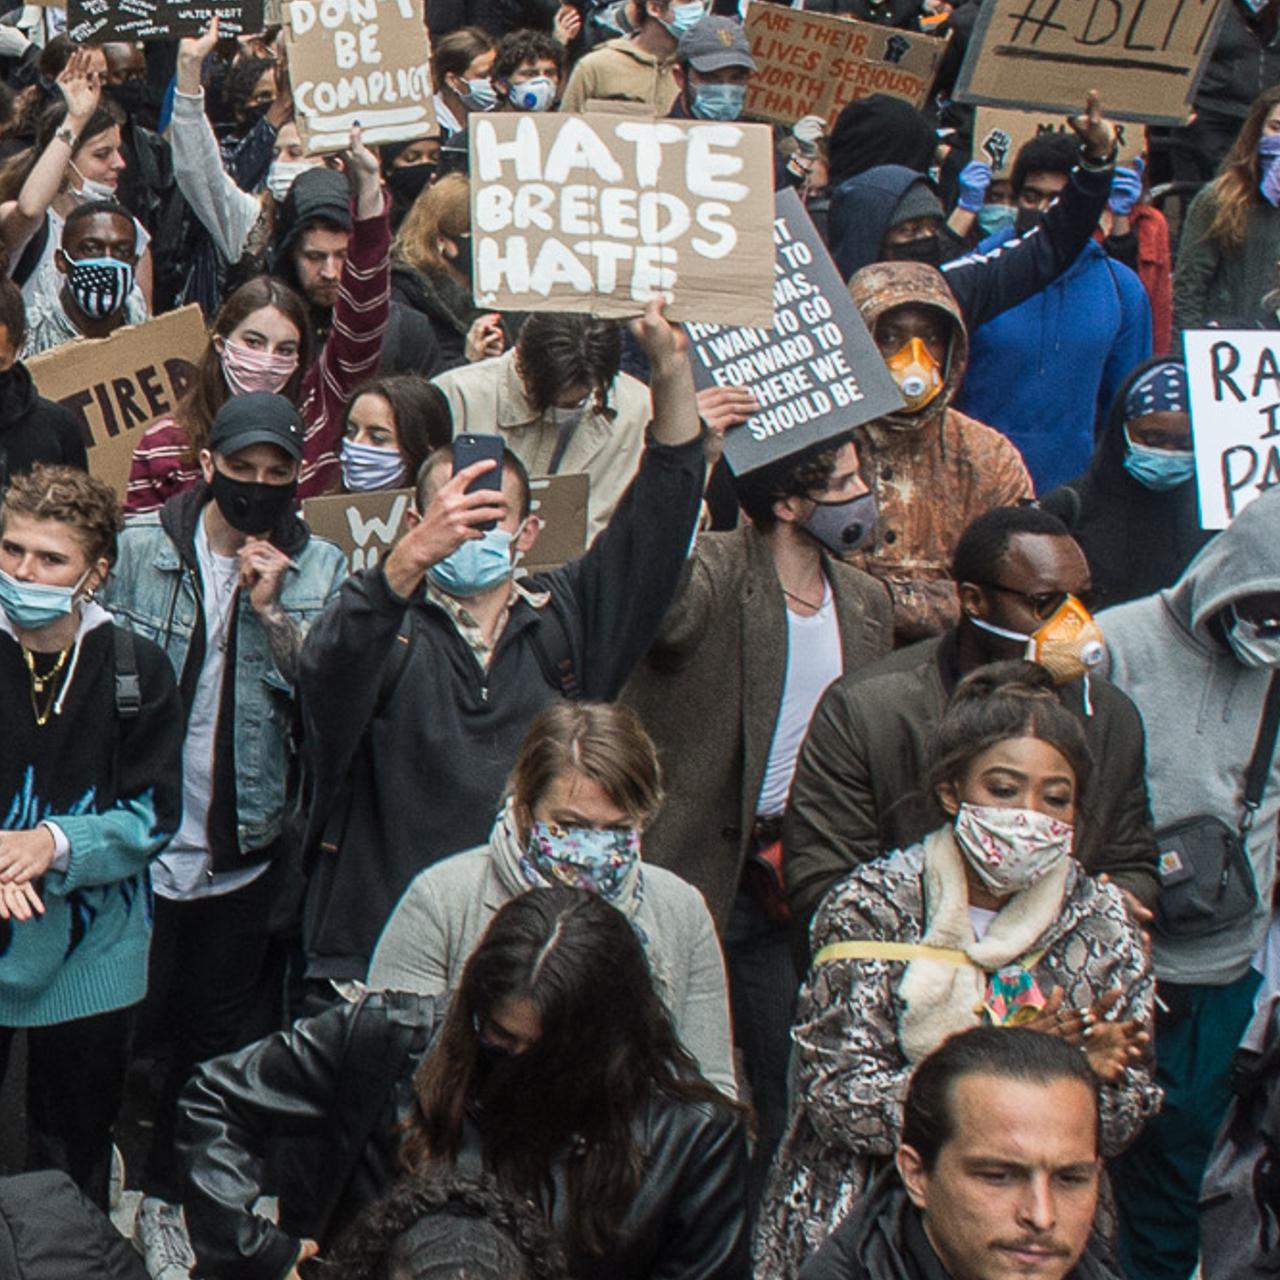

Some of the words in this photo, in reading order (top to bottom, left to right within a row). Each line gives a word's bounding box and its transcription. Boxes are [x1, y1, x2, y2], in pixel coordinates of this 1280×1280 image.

[334, 23, 382, 69] BE
[750, 10, 796, 36] ARE
[802, 17, 869, 56] THEIR
[753, 37, 821, 73] LIVES
[748, 88, 814, 118] THAN
[478, 118, 750, 204] HATE
[475, 184, 738, 261] BREEDS
[476, 237, 680, 304] HATE
[784, 242, 813, 274] TO
[698, 345, 708, 367] I
[711, 326, 769, 365] WANT
[773, 305, 800, 333] TO
[798, 294, 833, 324] GO
[711, 336, 815, 390] FORWARD
[816, 322, 845, 348] TO
[807, 351, 852, 384] WE
[60, 359, 202, 447] TIRED
[748, 392, 832, 443] SHOULD
[832, 379, 864, 405] BE
